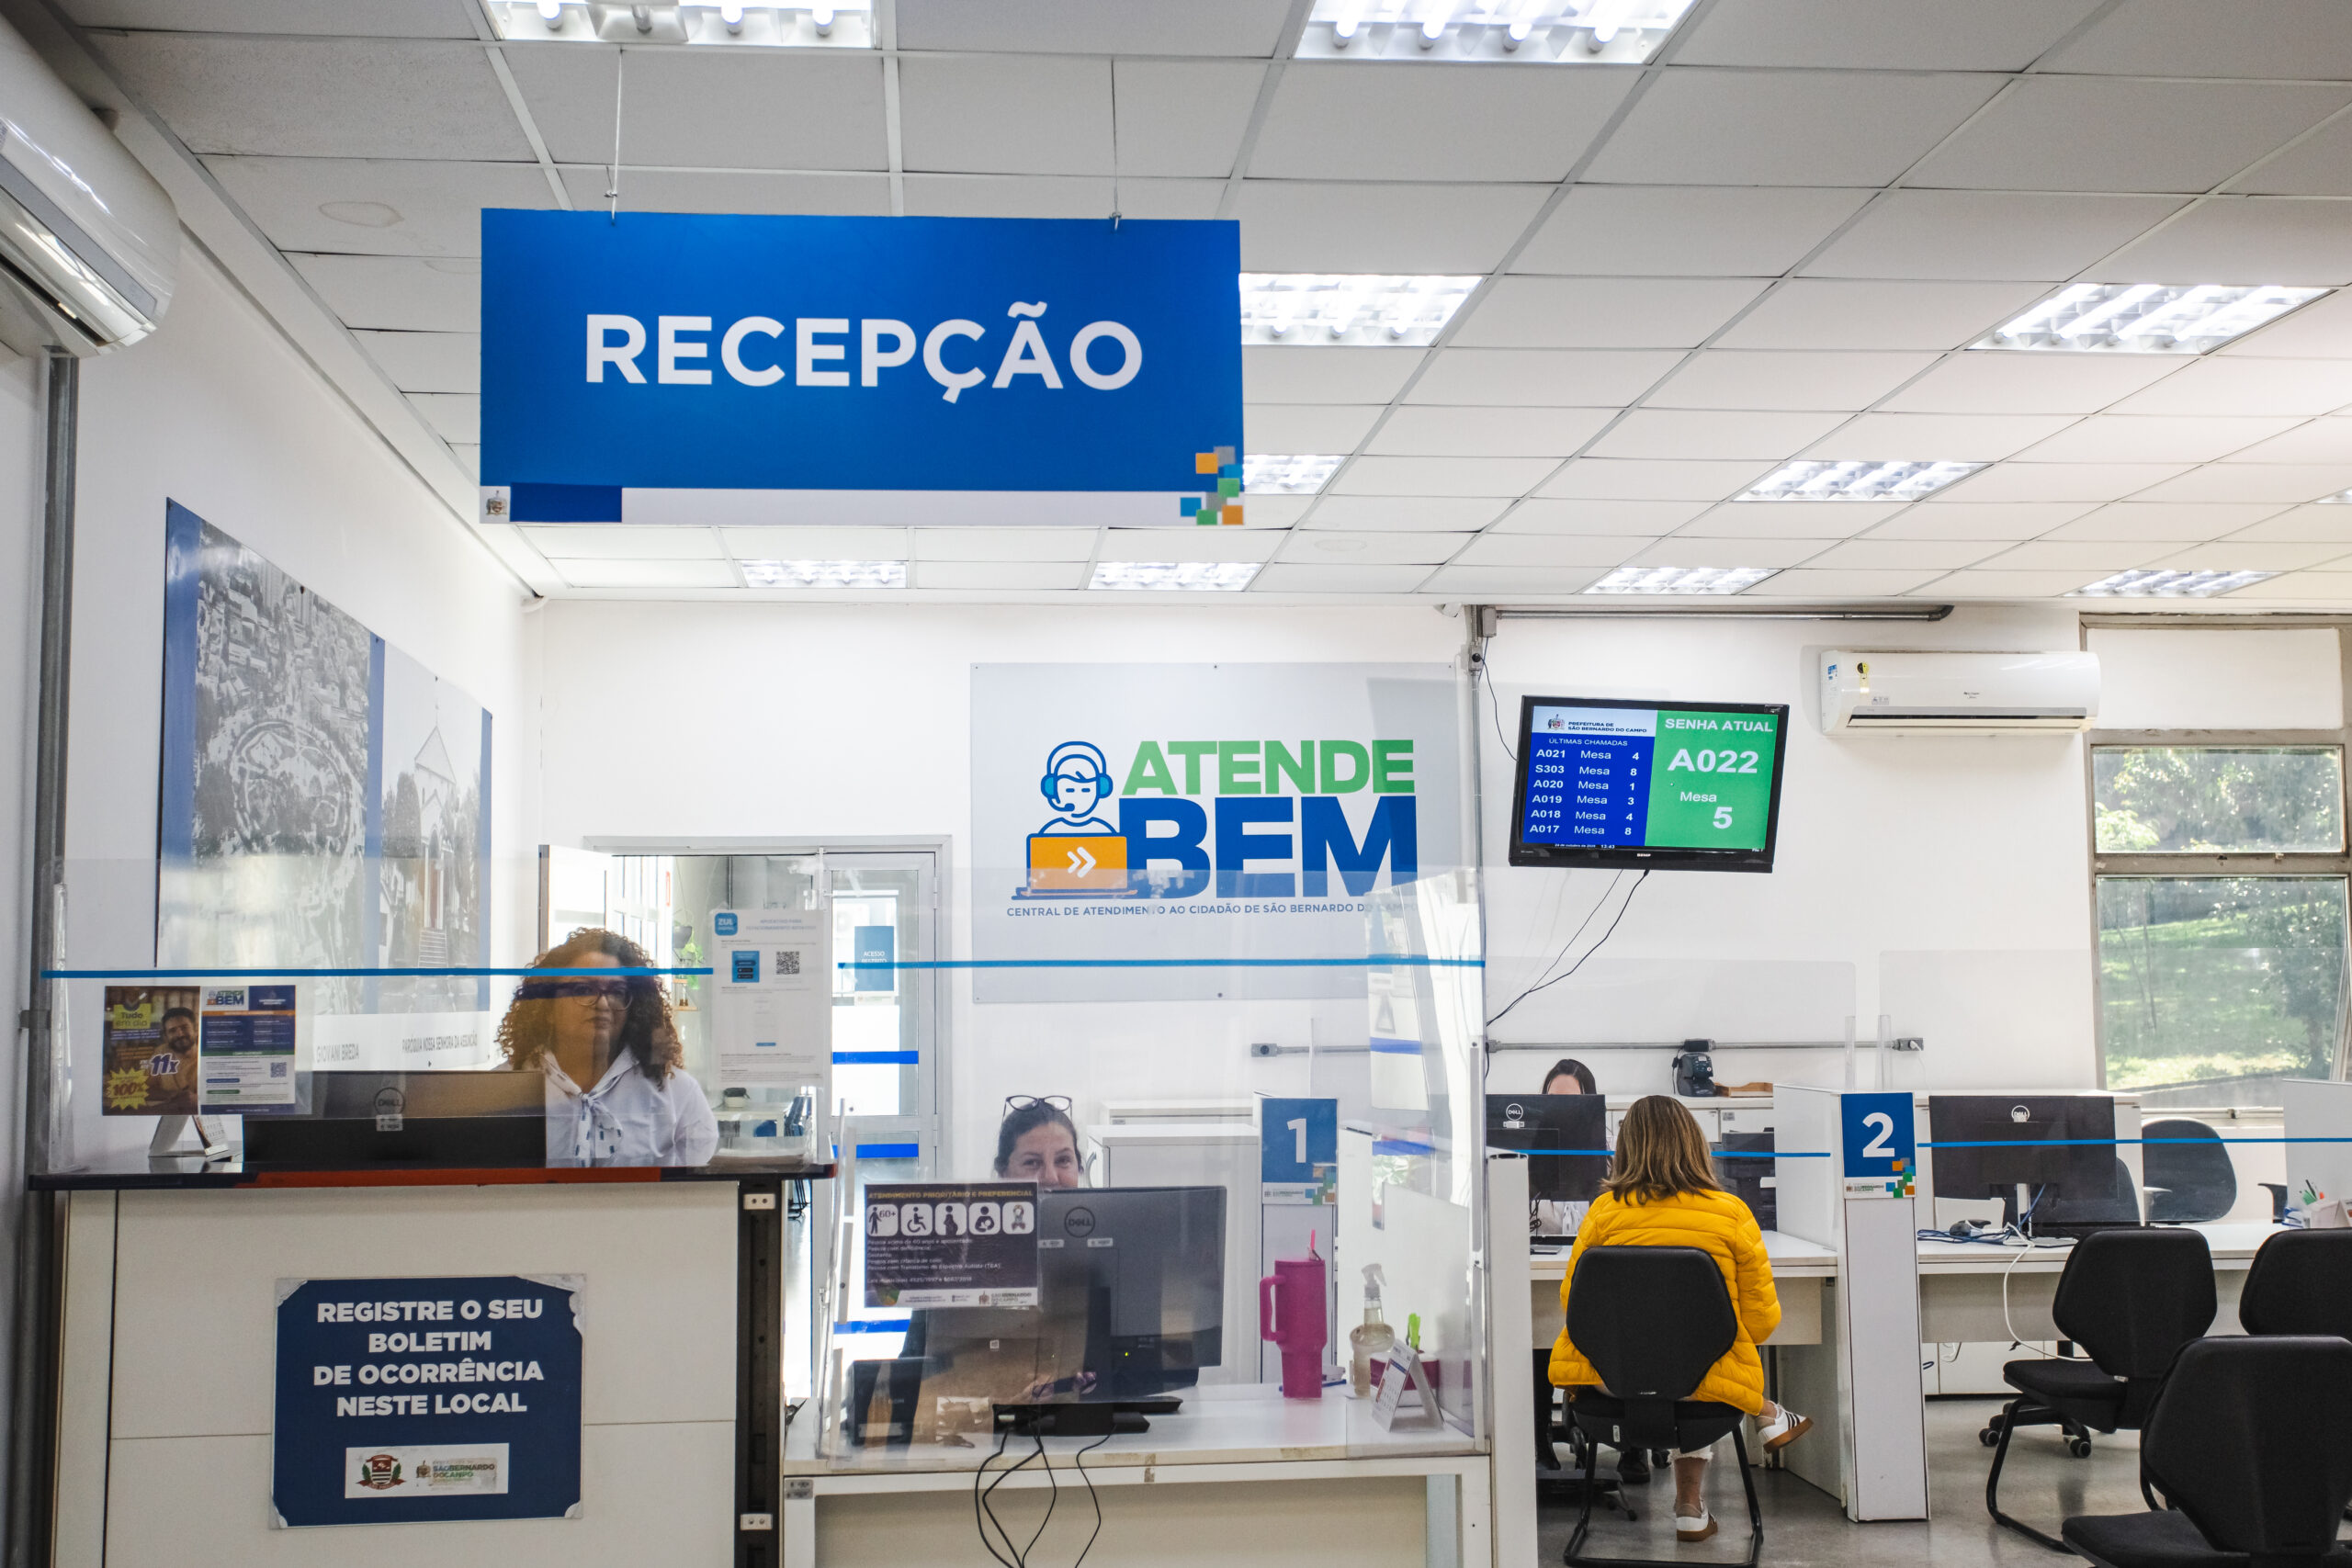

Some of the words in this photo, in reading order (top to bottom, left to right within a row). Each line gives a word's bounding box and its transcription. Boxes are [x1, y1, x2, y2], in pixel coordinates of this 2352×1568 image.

[585, 301, 1142, 404] RECEPÇÃO
[1665, 718, 1718, 730] SENHA
[1721, 720, 1773, 732] ATUAL
[1549, 737, 1582, 745] ÚLTIMAS
[1535, 749, 1566, 758] A021
[1580, 750, 1611, 760] Mesa
[1632, 752, 1640, 761] 4
[1668, 749, 1759, 773] A022
[1122, 739, 1416, 796] ATENDE
[1535, 764, 1565, 773] S303
[1578, 766, 1610, 775] Mesa
[1630, 768, 1637, 776] 8
[1533, 779, 1564, 789] A020
[1577, 781, 1609, 790] Mesa
[1629, 783, 1635, 791] 1
[1532, 795, 1562, 804] A019
[1577, 795, 1607, 805] Mesa
[1627, 797, 1634, 806] 3
[1679, 792, 1717, 803] Mesa
[1531, 809, 1561, 818] A018
[1575, 811, 1606, 820] Mesa
[1625, 813, 1634, 821] 4
[1713, 807, 1733, 829] 5
[1529, 825, 1559, 834] A017
[1574, 826, 1605, 835] Mesa
[1624, 828, 1632, 836] 8
[1118, 795, 1419, 899] BEM
[1007, 908, 1060, 917] CENTRAL
[1064, 907, 1080, 916] DE
[1082, 906, 1166, 916] ATENDIMENO
[1169, 906, 1186, 915] AO
[1189, 903, 1241, 915] CIDADÃO
[1244, 905, 1260, 914] DE
[1263, 902, 1286, 913] SÃO
[1290, 903, 1353, 913] BERNARDO
[1357, 904, 1374, 912] DO
[216, 995, 244, 1005] BEM
[1287, 1118, 1306, 1163] 1
[1862, 1112, 1895, 1157] 2
[1068, 1218, 1091, 1226] DELL
[317, 1301, 454, 1323] REGISTRE
[460, 1300, 482, 1320] O
[488, 1299, 544, 1319] SEU
[368, 1331, 492, 1353] BOLETIM
[313, 1365, 352, 1386] DE
[357, 1358, 545, 1385] OCORRÊNCIA
[336, 1394, 428, 1416] NESTE
[435, 1393, 527, 1415] LOCAL
